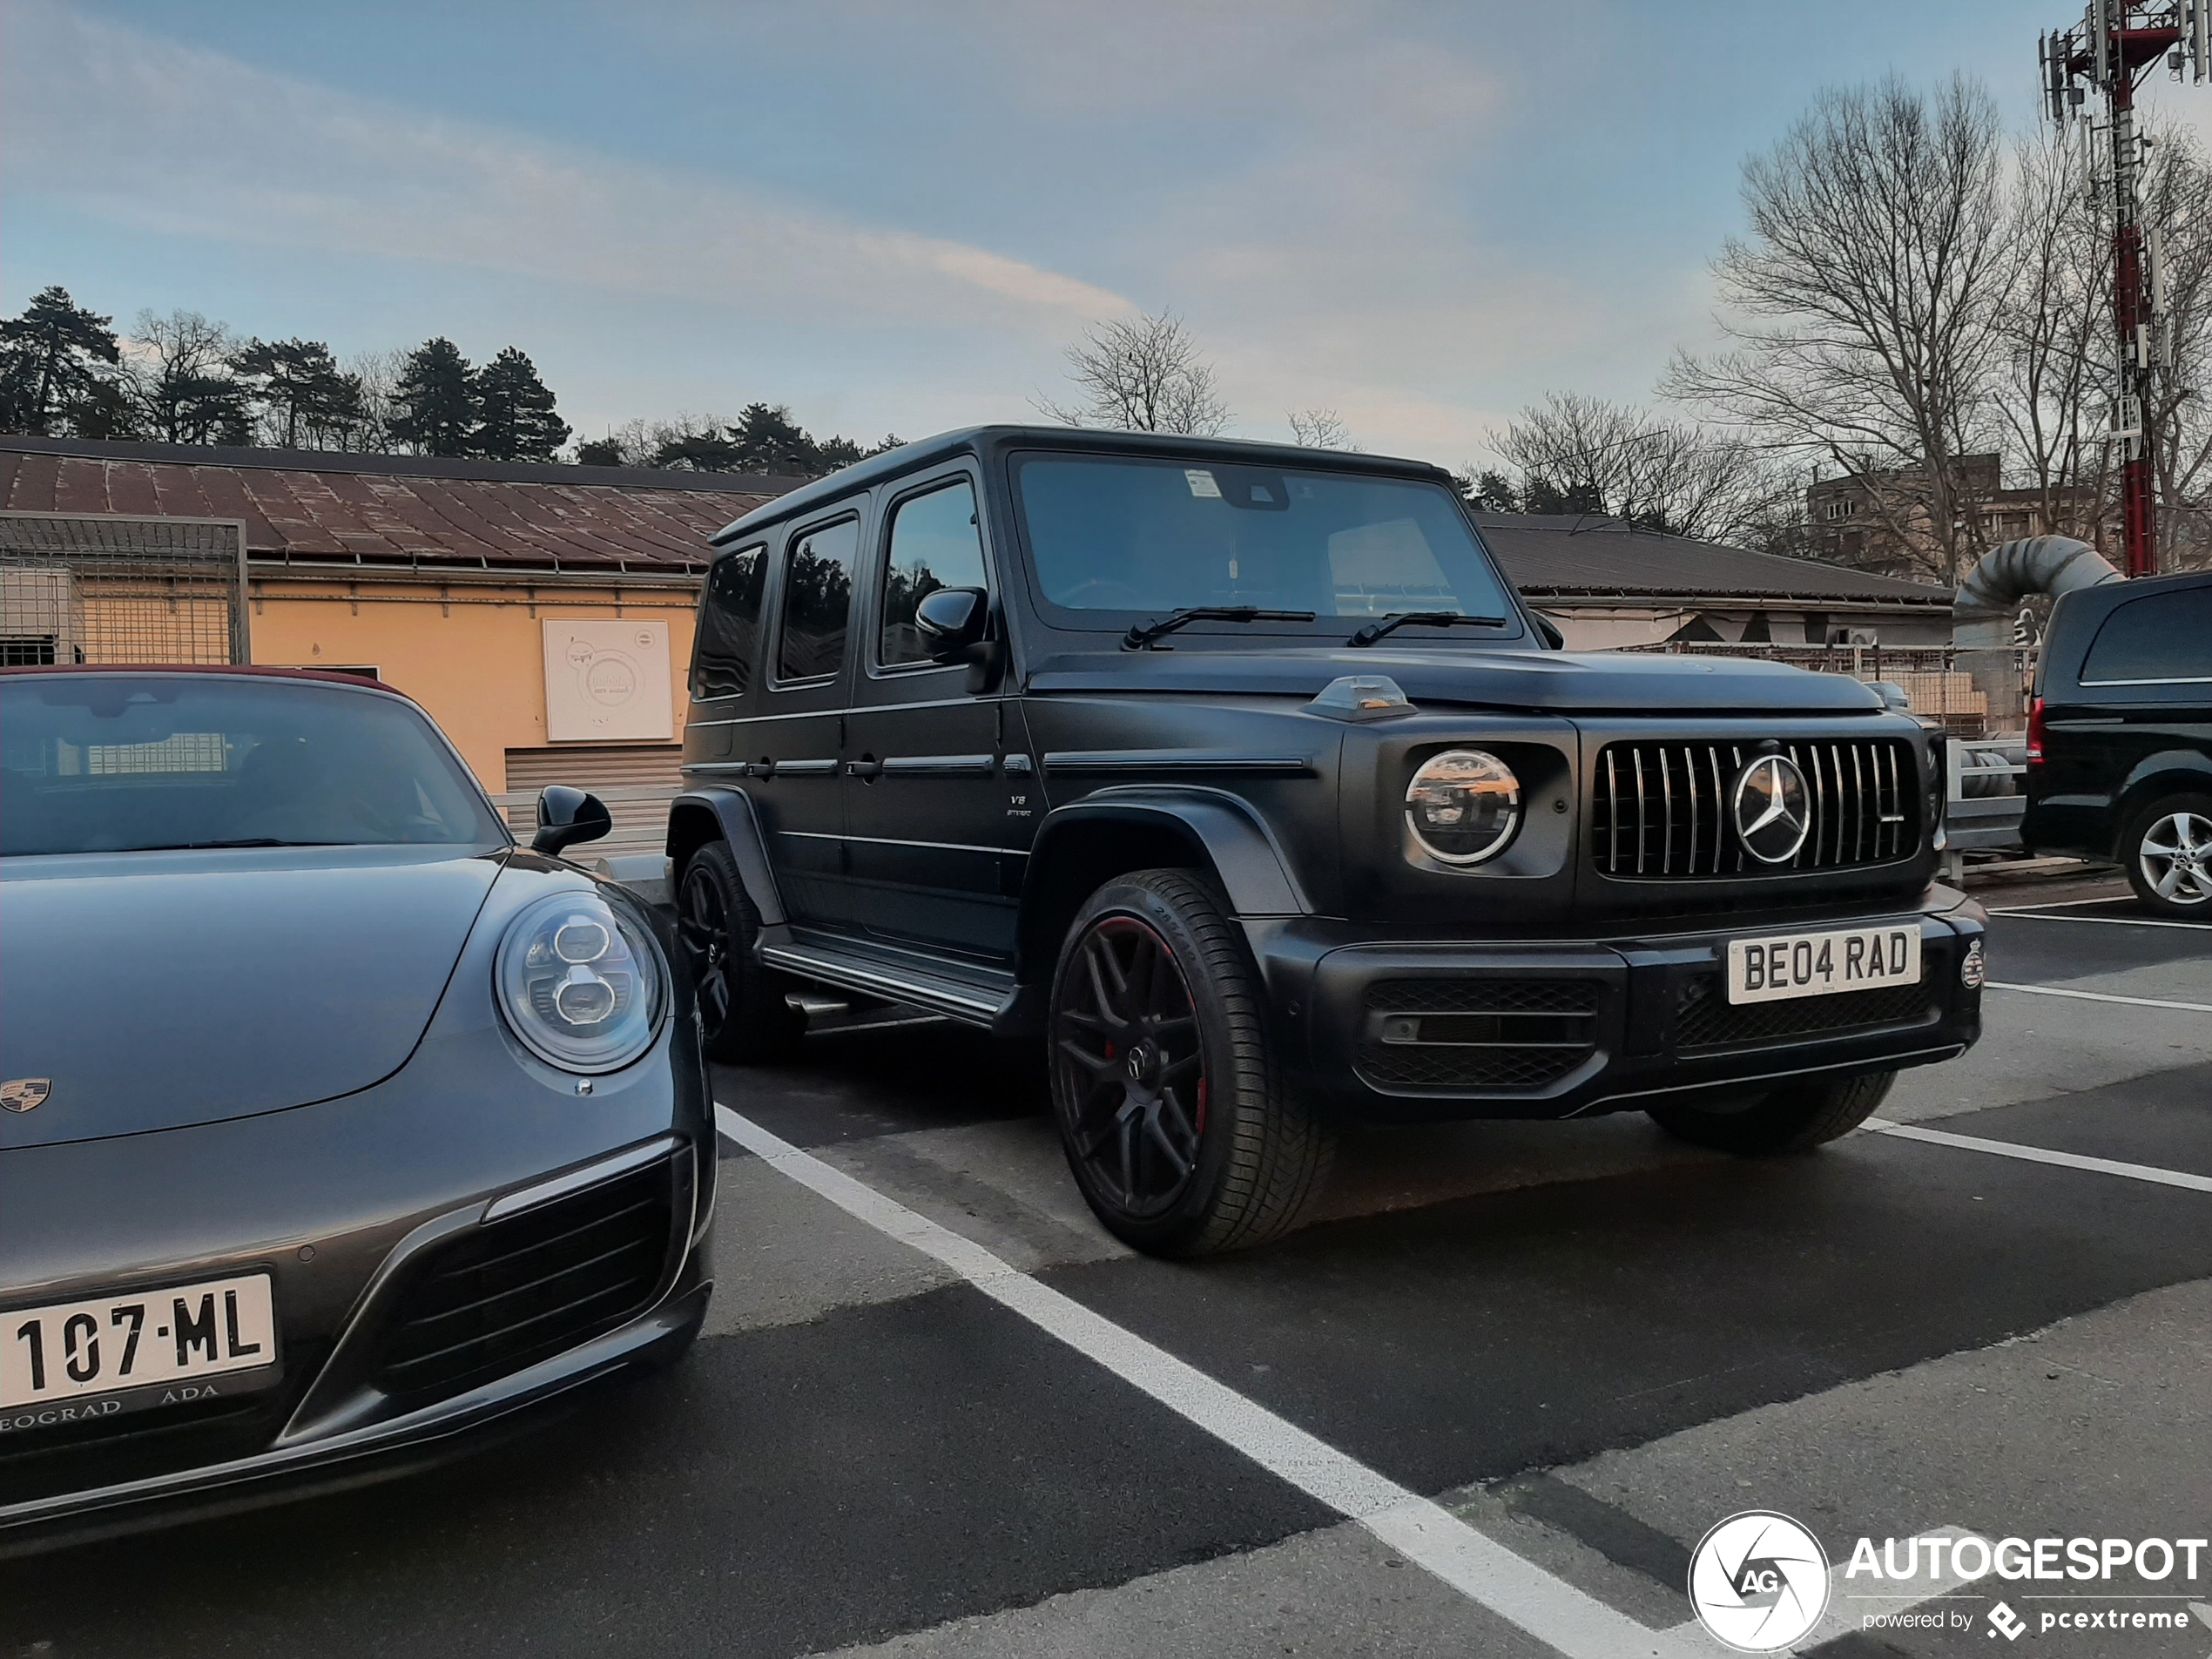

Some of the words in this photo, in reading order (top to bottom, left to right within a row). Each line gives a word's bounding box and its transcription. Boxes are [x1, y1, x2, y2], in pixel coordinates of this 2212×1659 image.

[1010, 795, 1026, 805] V8
[1844, 932, 1907, 981] RAD
[161, 1384, 219, 1405] ADA
